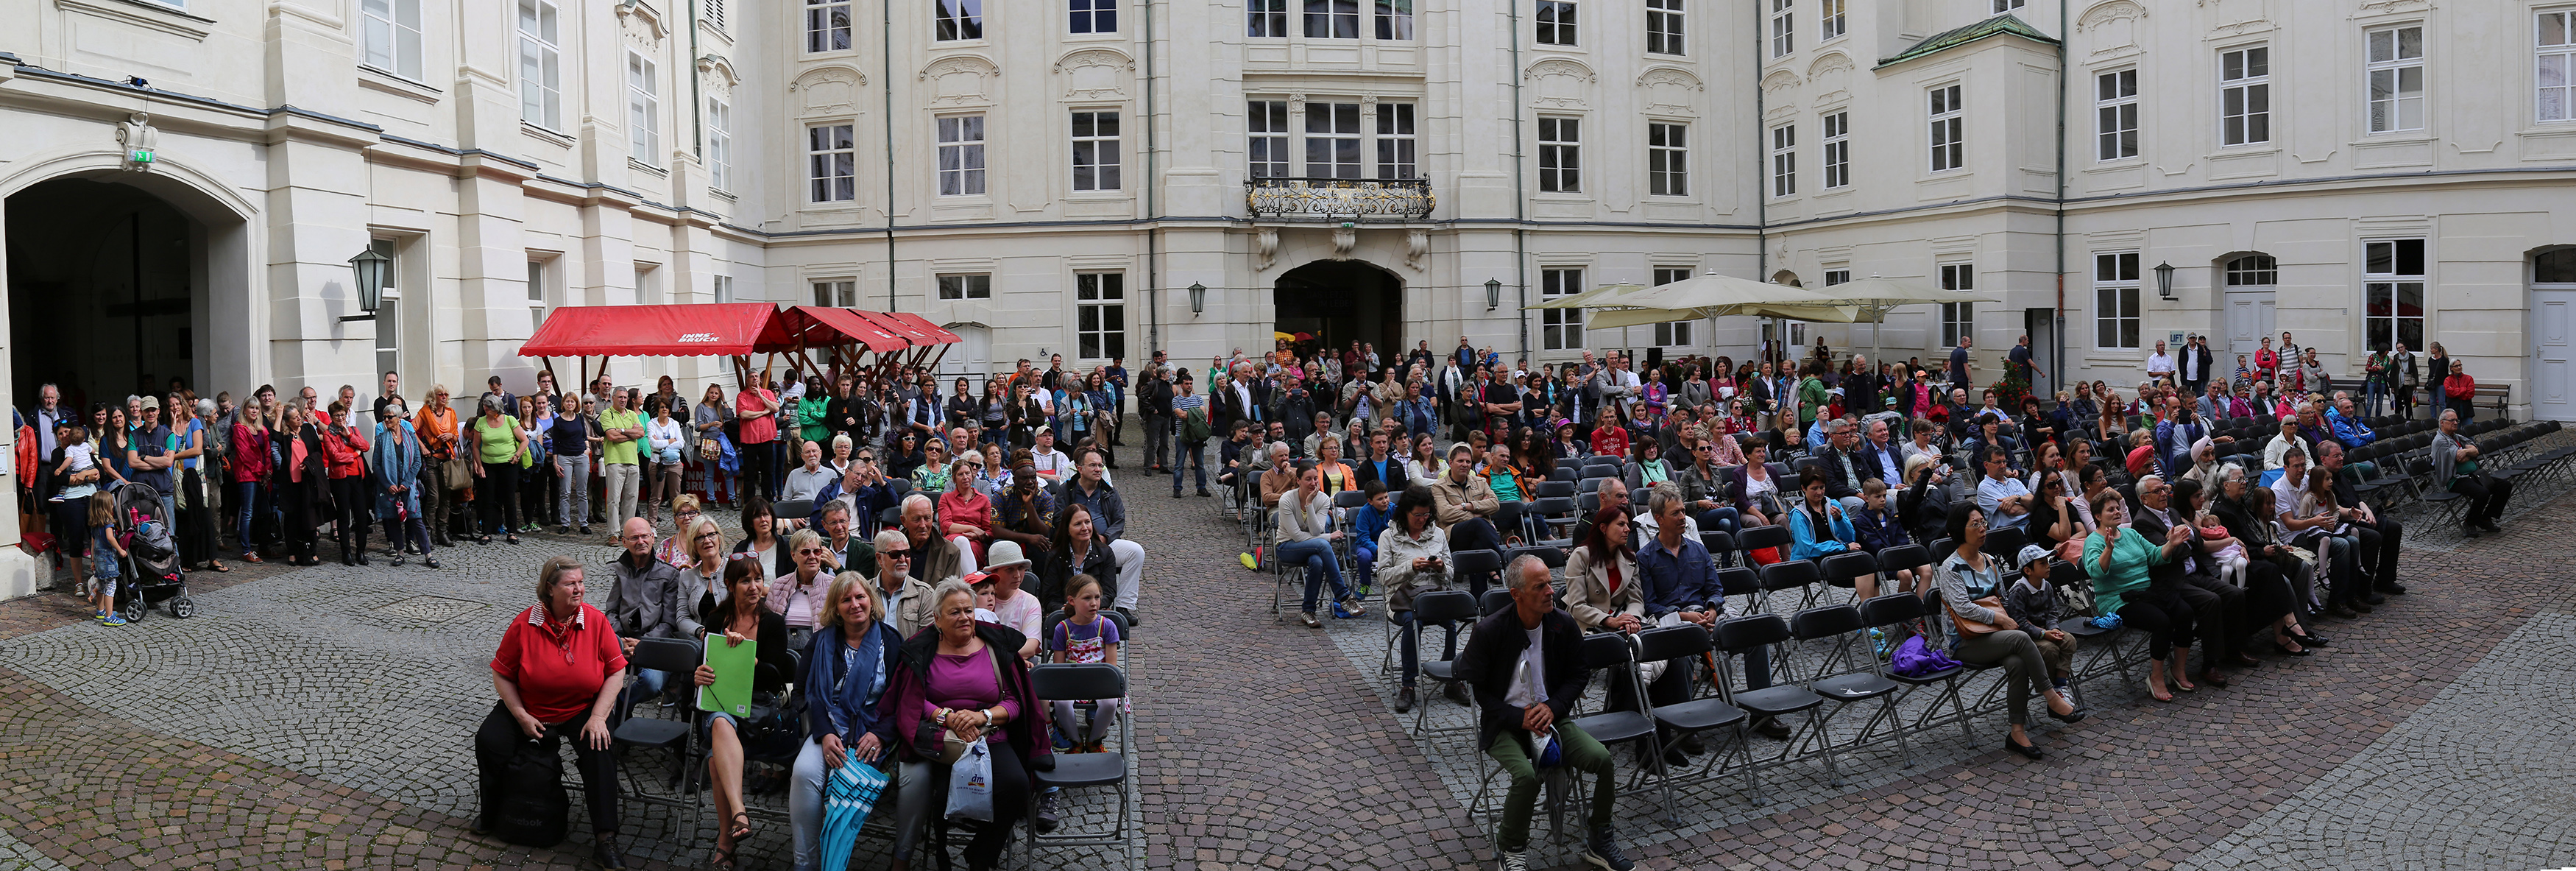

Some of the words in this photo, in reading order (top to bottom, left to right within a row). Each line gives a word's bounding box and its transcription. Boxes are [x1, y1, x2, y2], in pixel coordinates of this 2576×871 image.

[685, 471, 706, 480] INN
[686, 482, 722, 491] BRUK
[971, 774, 984, 783] dm
